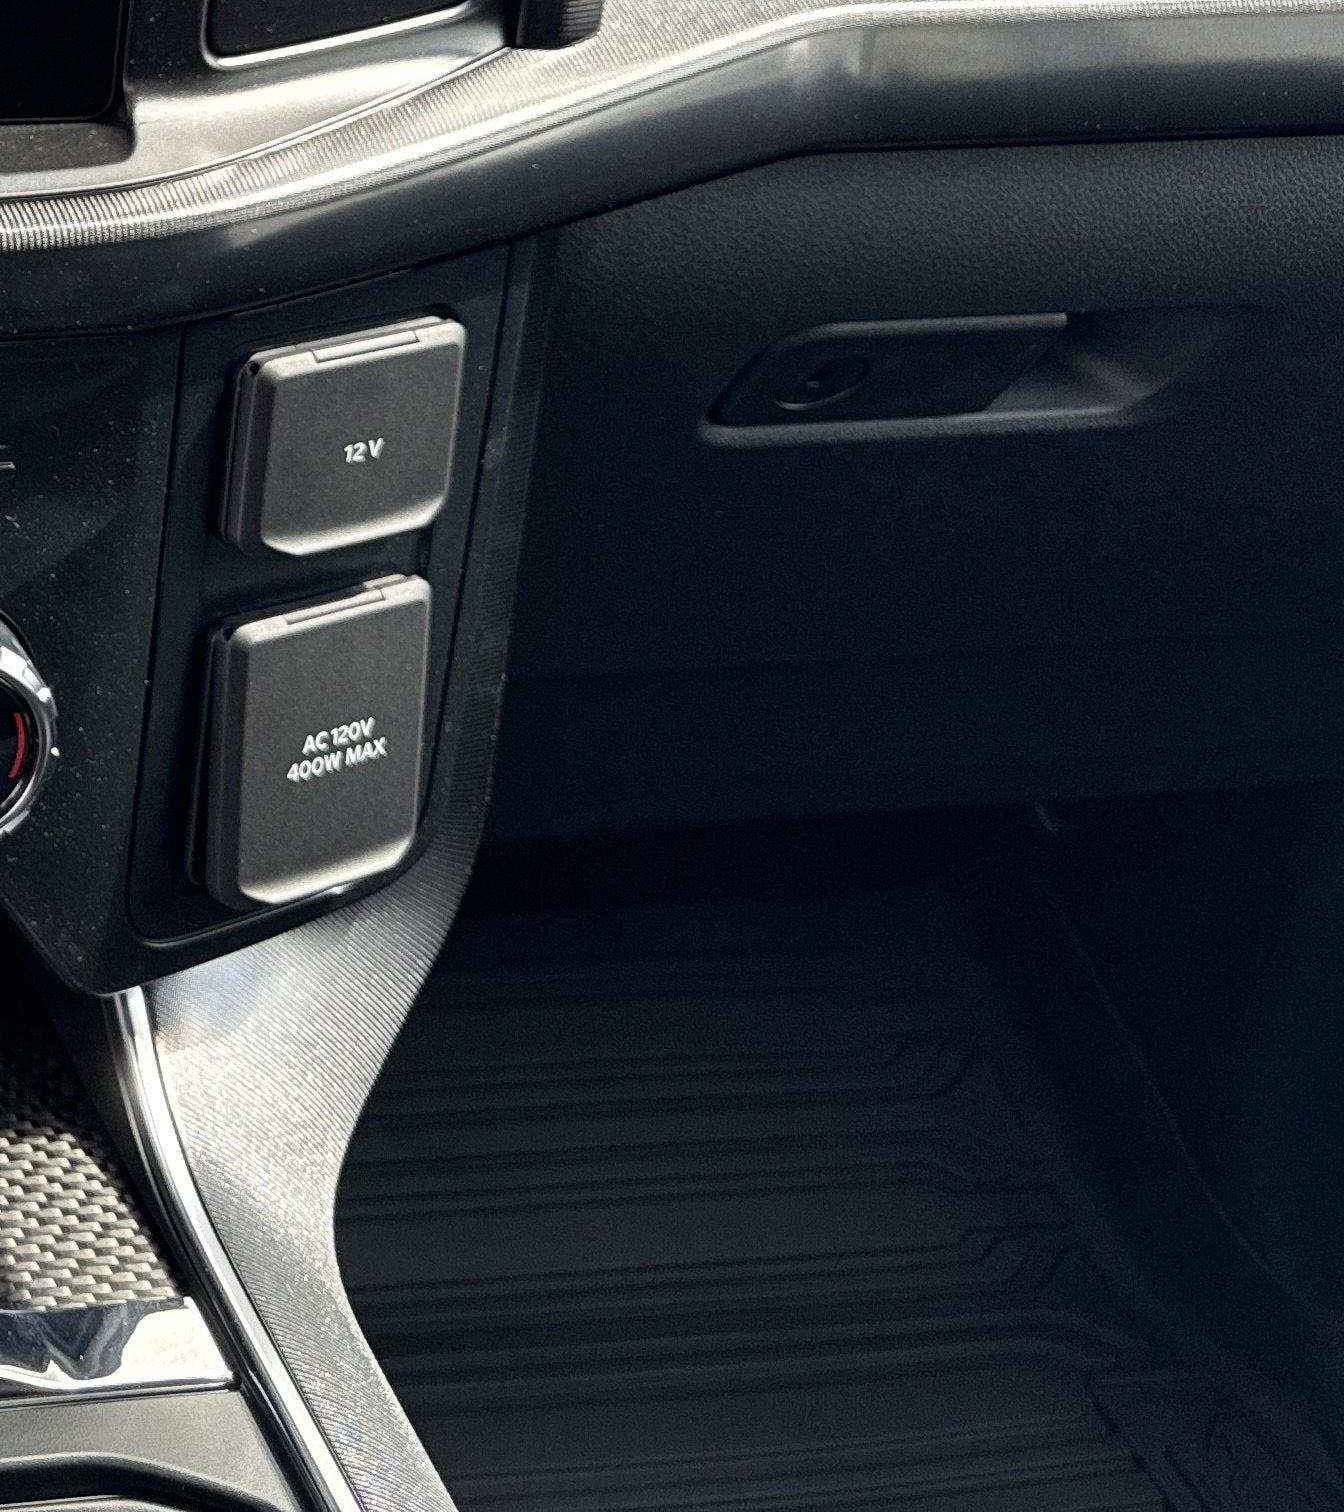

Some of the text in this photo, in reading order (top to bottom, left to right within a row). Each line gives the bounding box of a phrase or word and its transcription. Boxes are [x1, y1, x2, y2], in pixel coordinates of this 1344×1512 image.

[302, 717, 375, 754] AC 120V
[287, 737, 387, 781] 400W MAX
